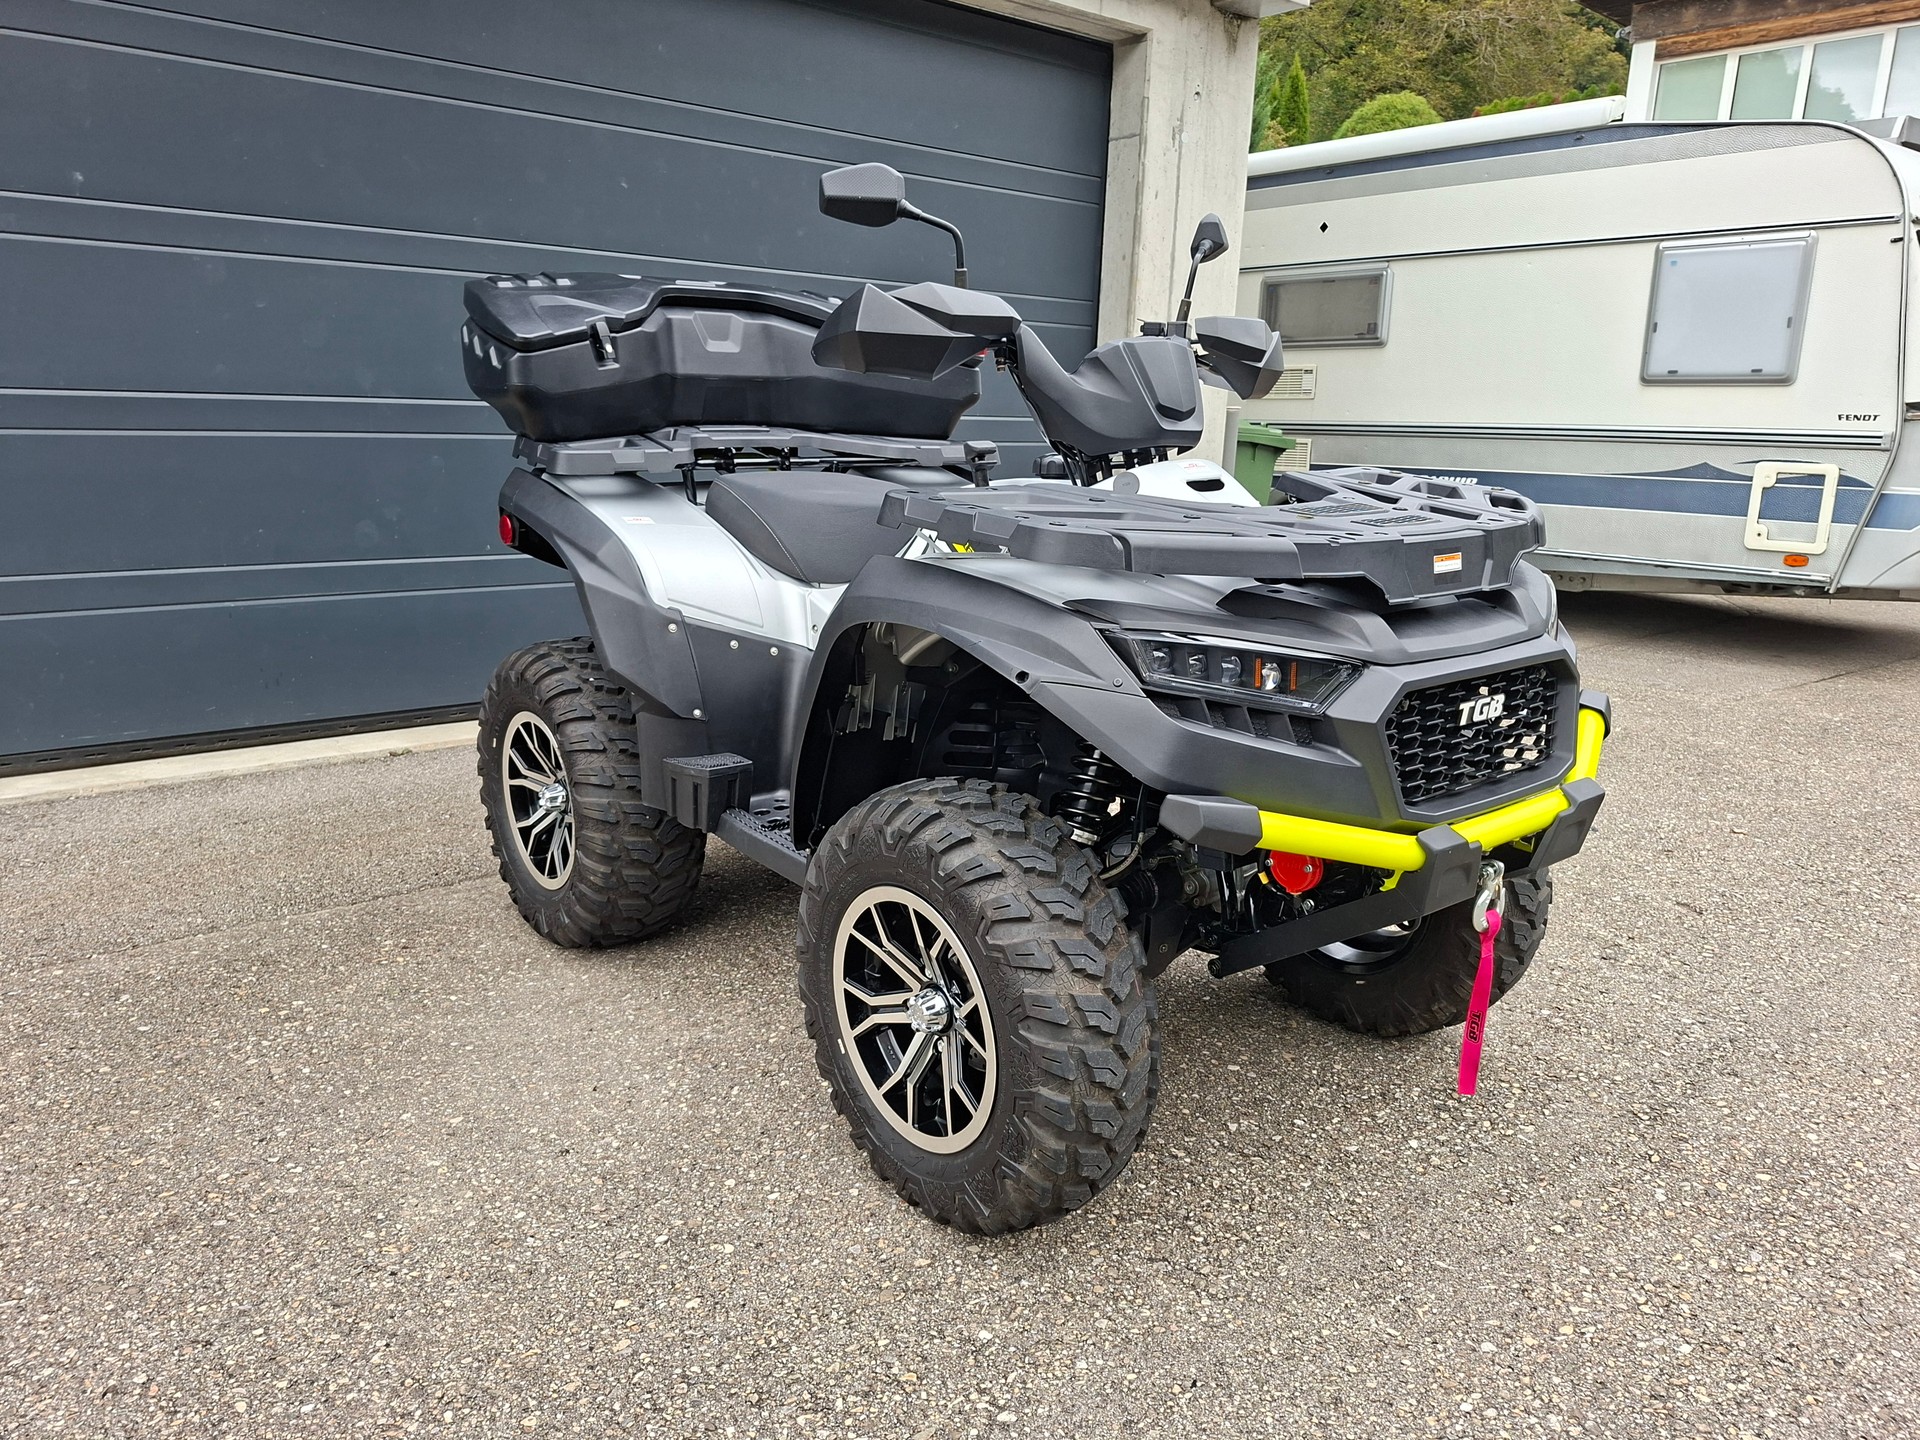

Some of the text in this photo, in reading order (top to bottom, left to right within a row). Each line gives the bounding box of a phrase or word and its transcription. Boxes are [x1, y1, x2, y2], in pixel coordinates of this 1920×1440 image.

[1838, 414, 1880, 422] FENDT
[1459, 693, 1505, 726] TGB
[1468, 1010, 1482, 1042] TGB
